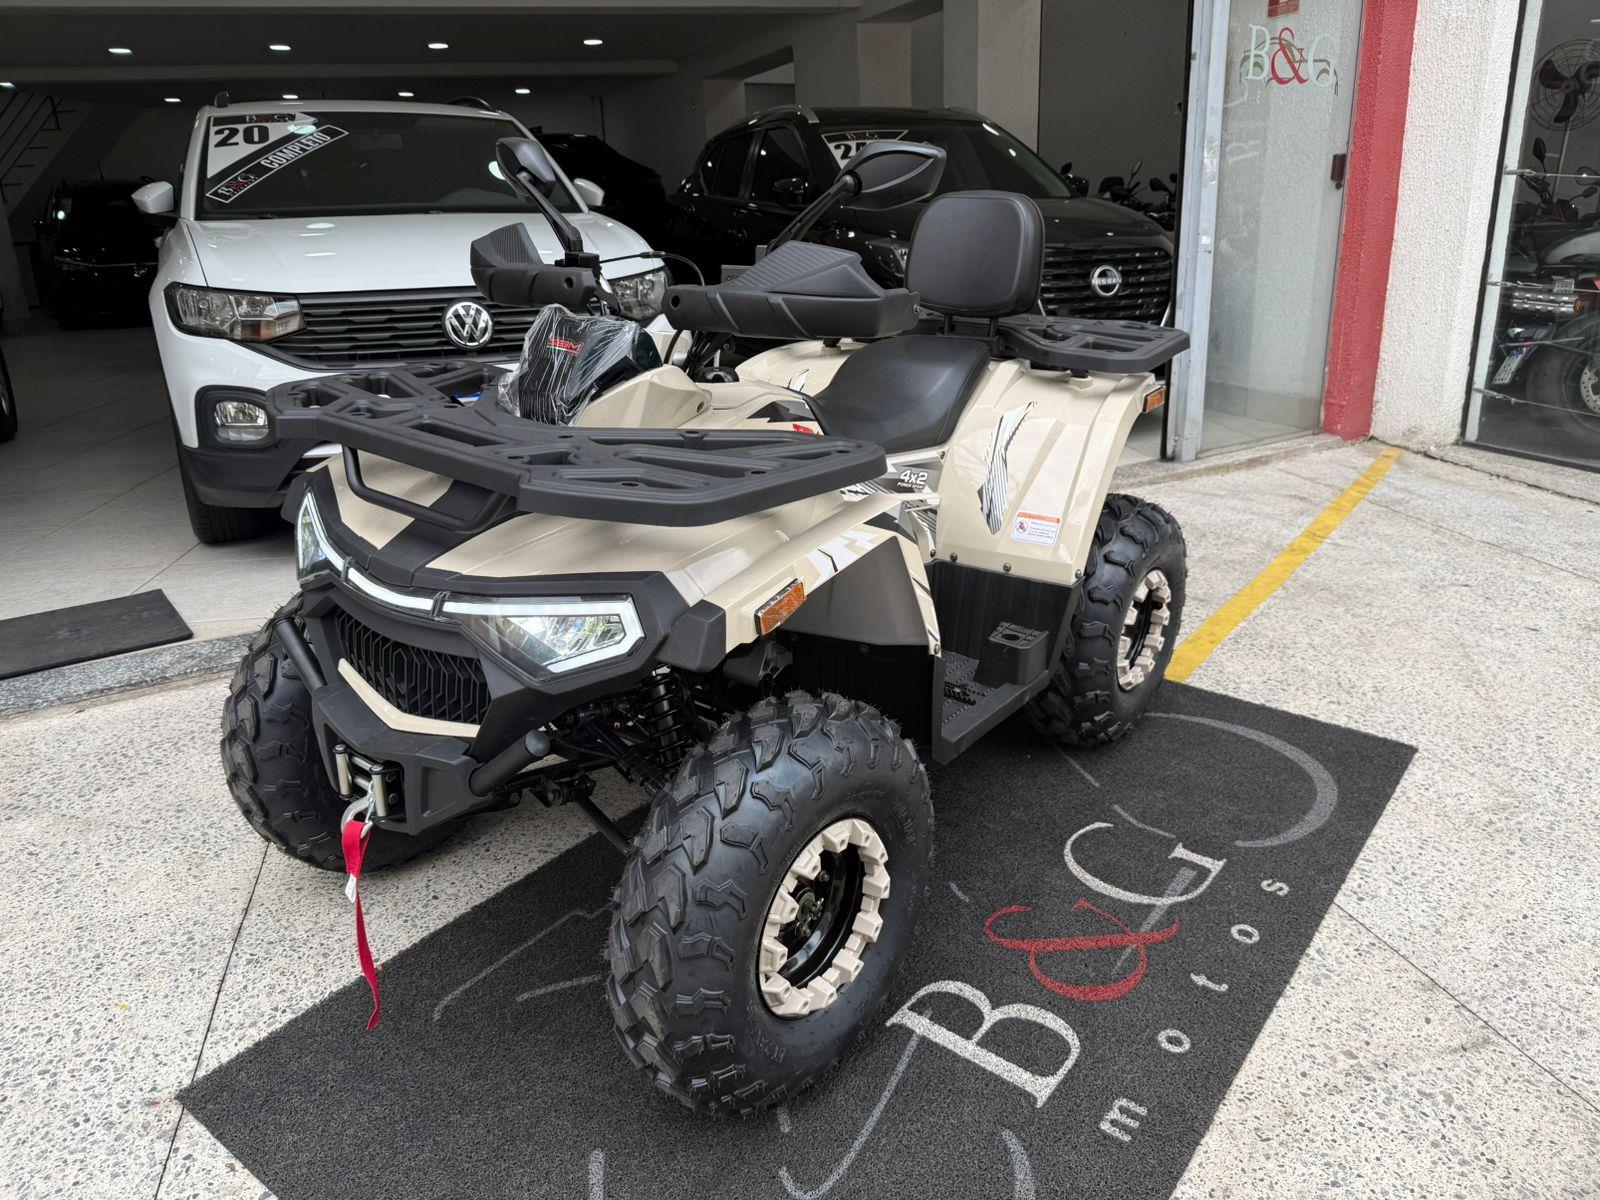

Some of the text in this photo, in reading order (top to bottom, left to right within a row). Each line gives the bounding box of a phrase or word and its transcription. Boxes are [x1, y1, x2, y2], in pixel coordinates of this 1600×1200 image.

[1244, 22, 1335, 87] B&G
[214, 124, 270, 148] 20
[260, 130, 331, 169] COMPLETO
[1091, 277, 1122, 286] NISSAN
[900, 469, 928, 484] 4x2
[884, 821, 1228, 1109] B&G
